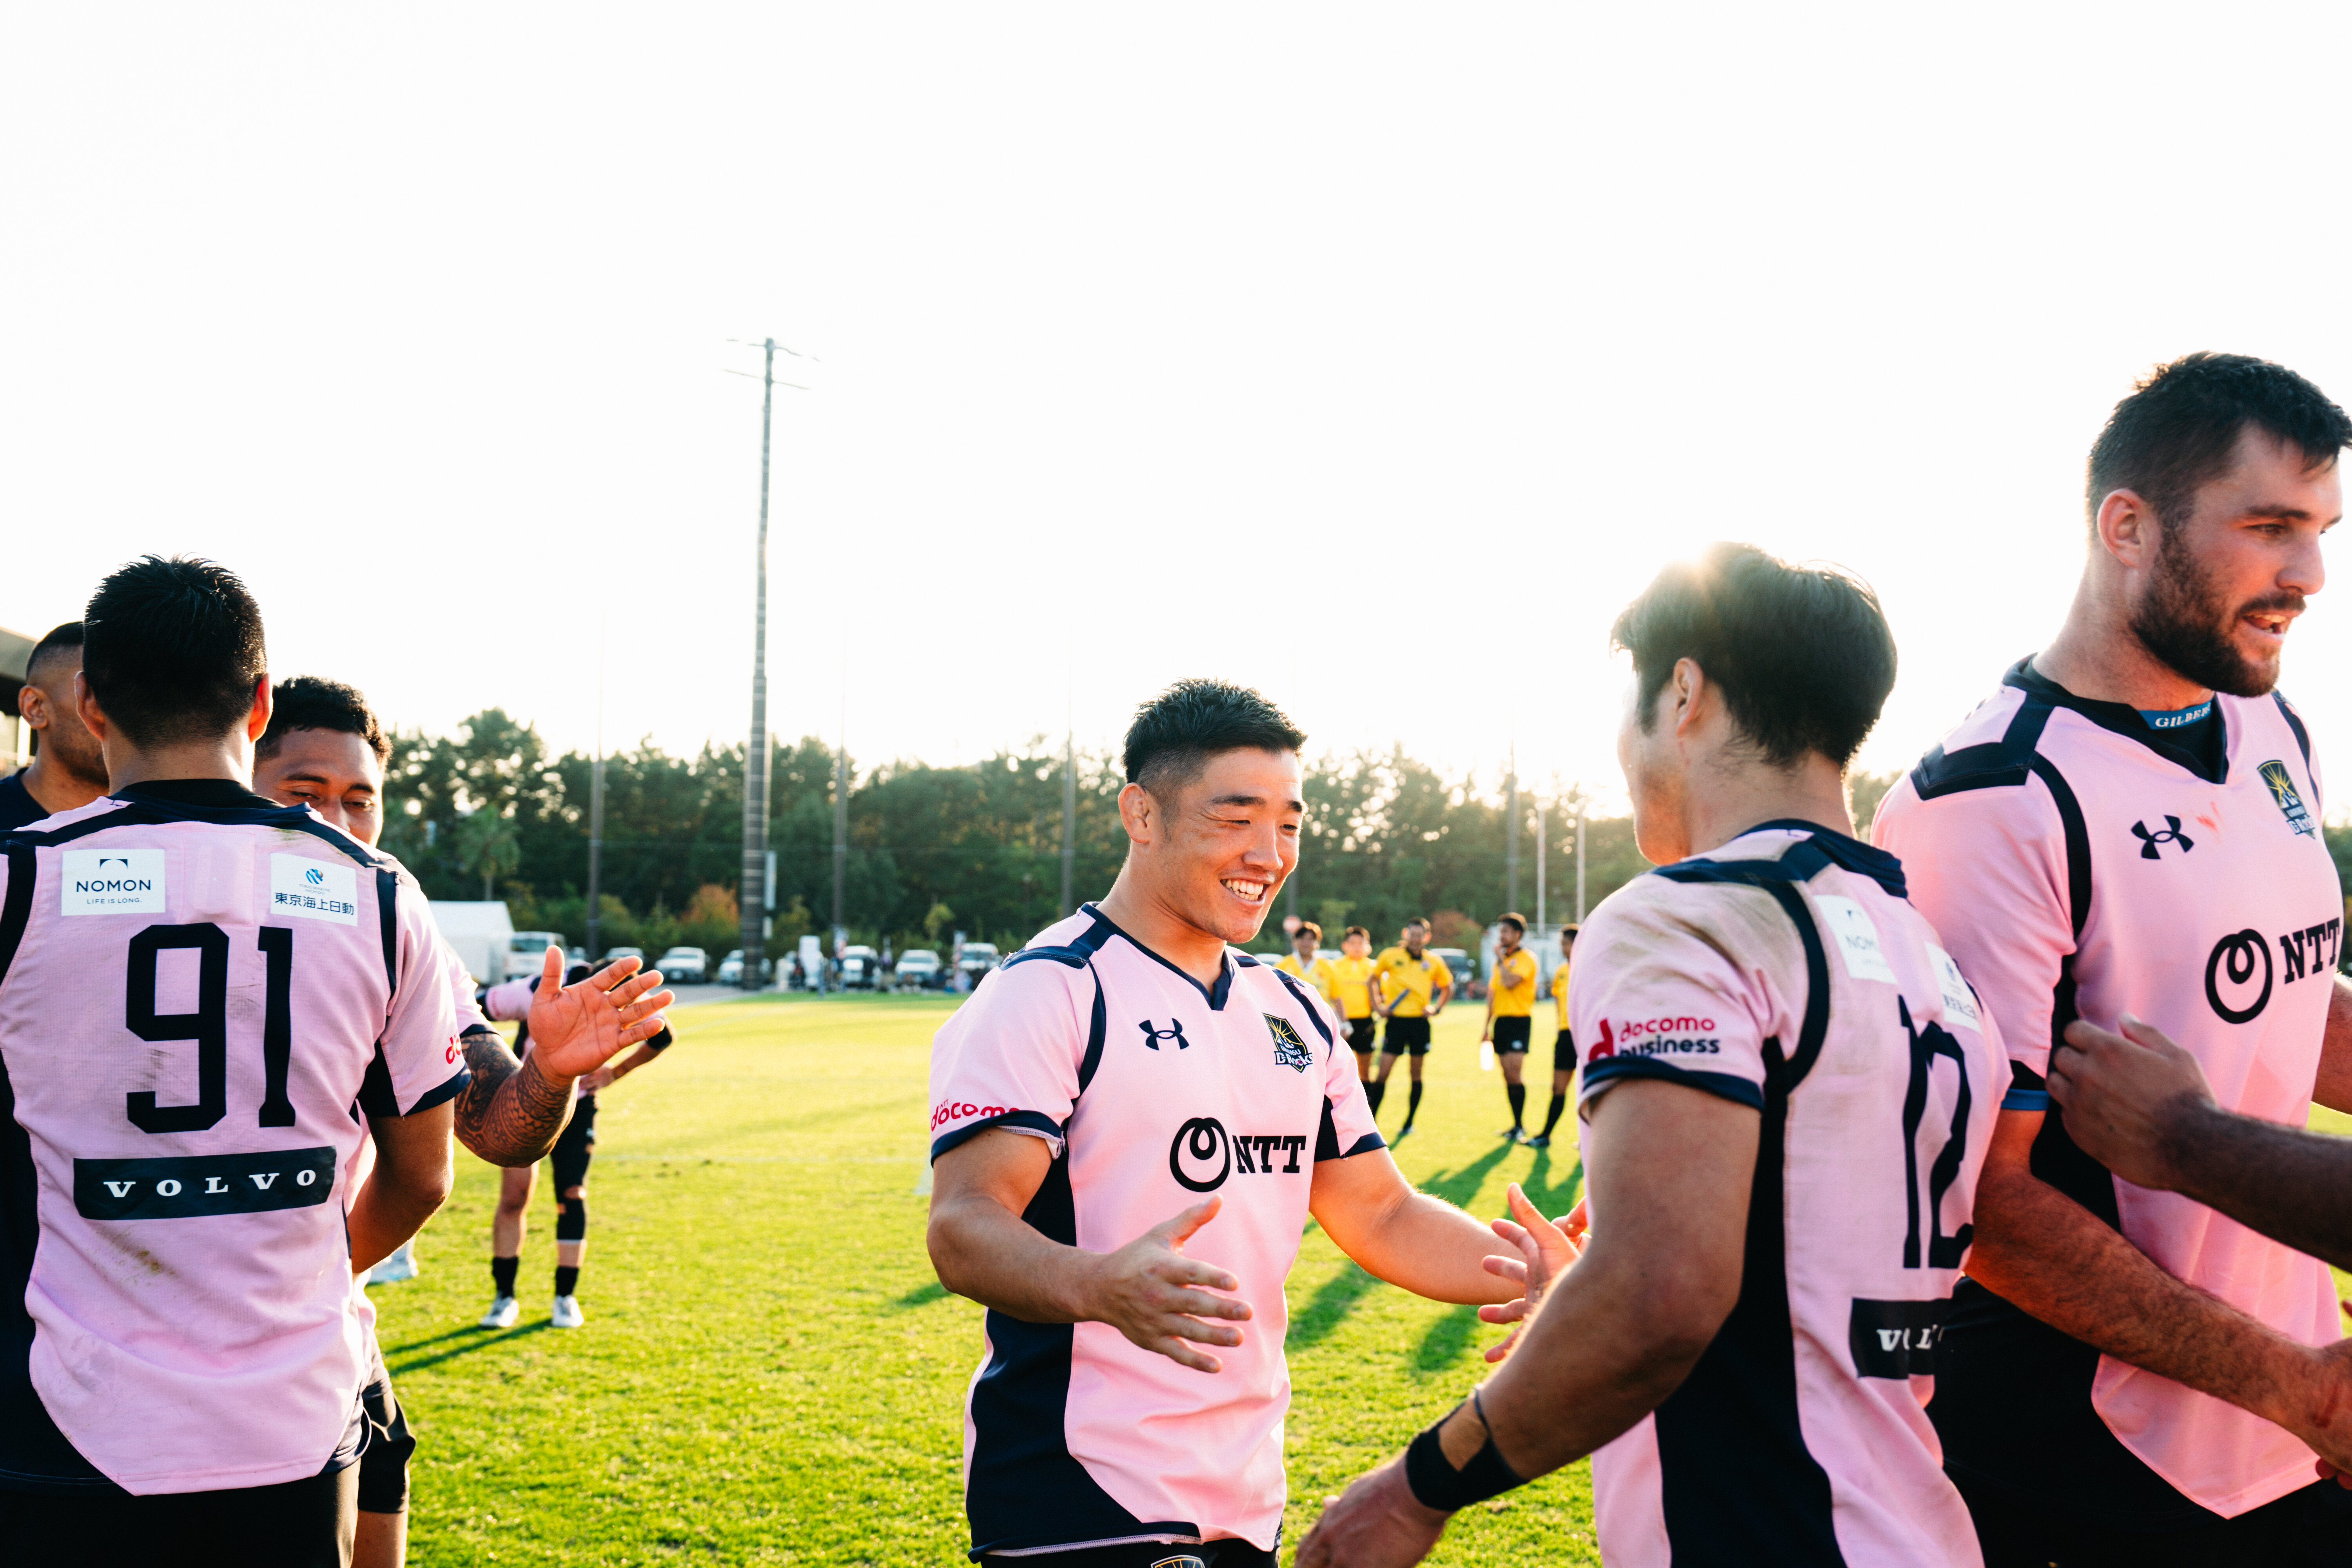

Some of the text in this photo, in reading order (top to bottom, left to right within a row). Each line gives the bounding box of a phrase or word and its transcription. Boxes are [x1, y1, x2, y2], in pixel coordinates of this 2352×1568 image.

[76, 879, 151, 893] NOMON
[275, 892, 354, 915] 東京海上日動
[2279, 916, 2340, 985] NTT
[126, 922, 296, 1134] 91
[1621, 1017, 1715, 1042] docomo
[940, 1099, 949, 1109] NTT
[1898, 994, 1974, 1269] 12
[1232, 1135, 1307, 1174] NTT
[103, 1169, 316, 1198] VOLVO
